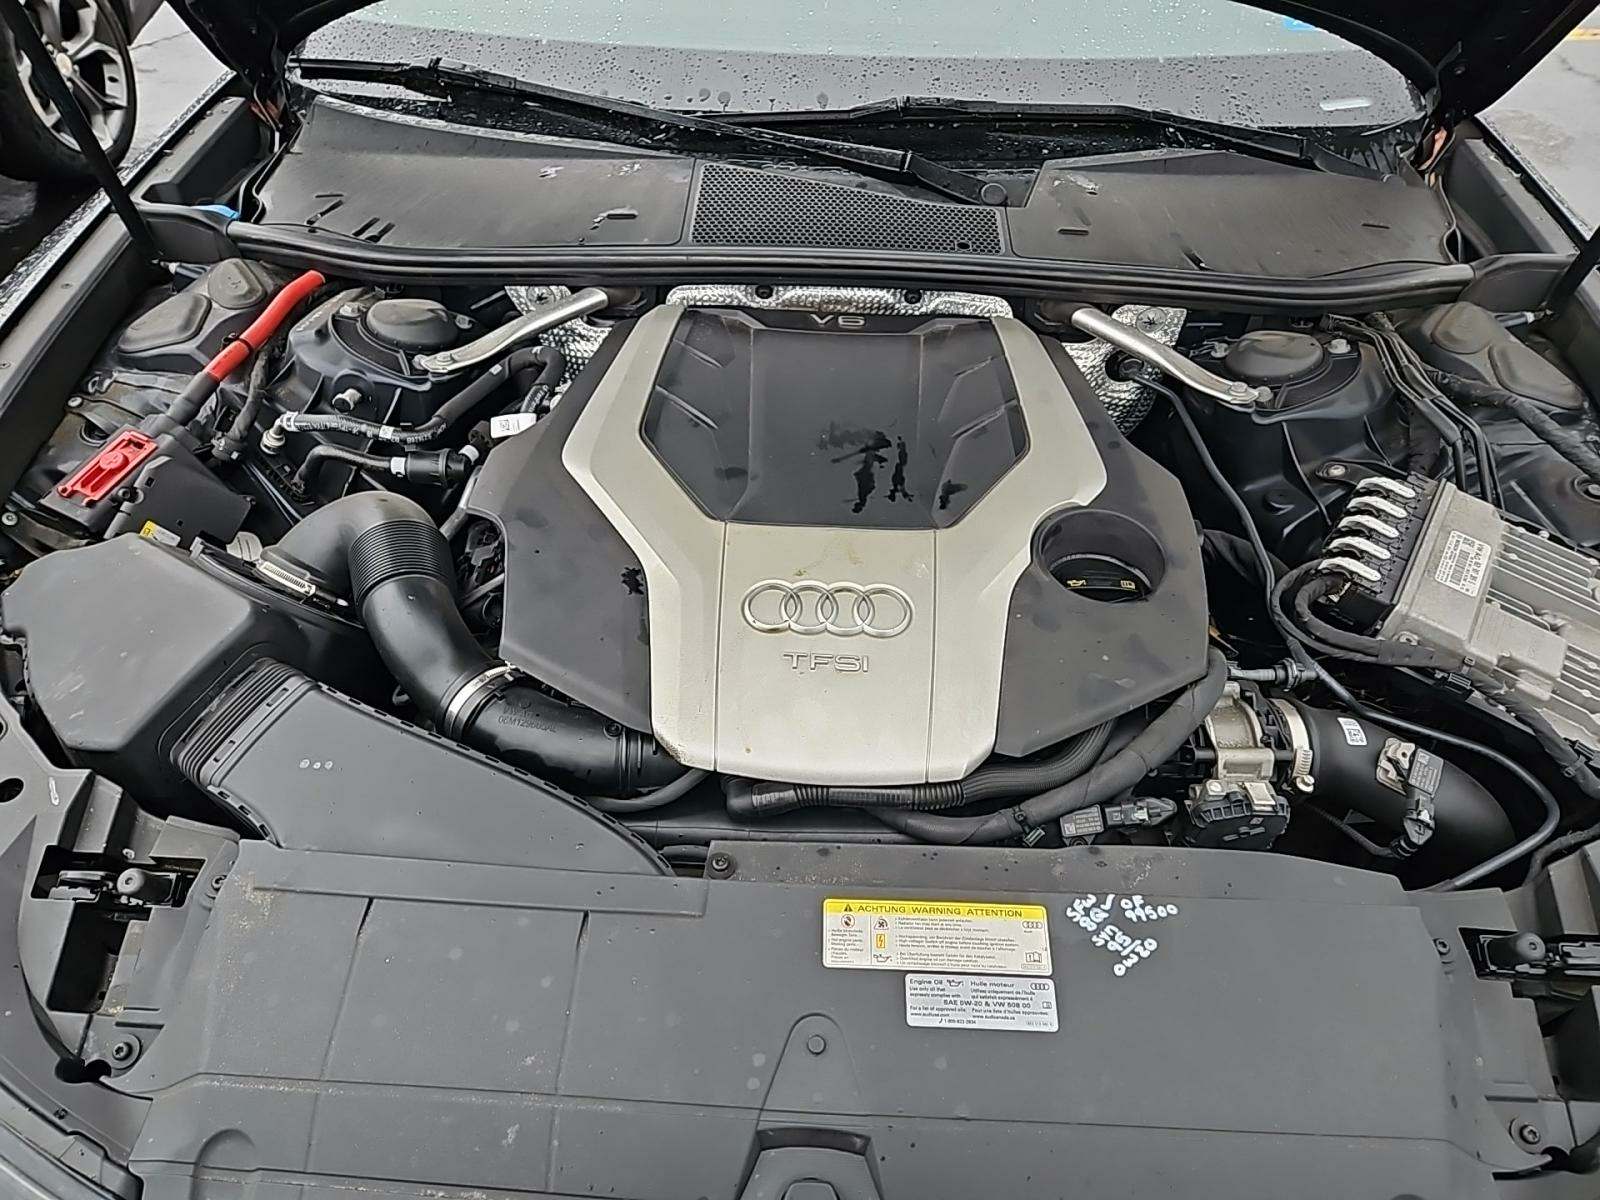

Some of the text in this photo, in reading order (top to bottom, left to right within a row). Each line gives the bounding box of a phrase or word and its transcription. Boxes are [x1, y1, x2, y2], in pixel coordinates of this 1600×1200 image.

[809, 313, 865, 329] V6
[783, 652, 868, 673] TFSI
[857, 904, 1023, 918] ACHTUNG WARNING ATTENTION
